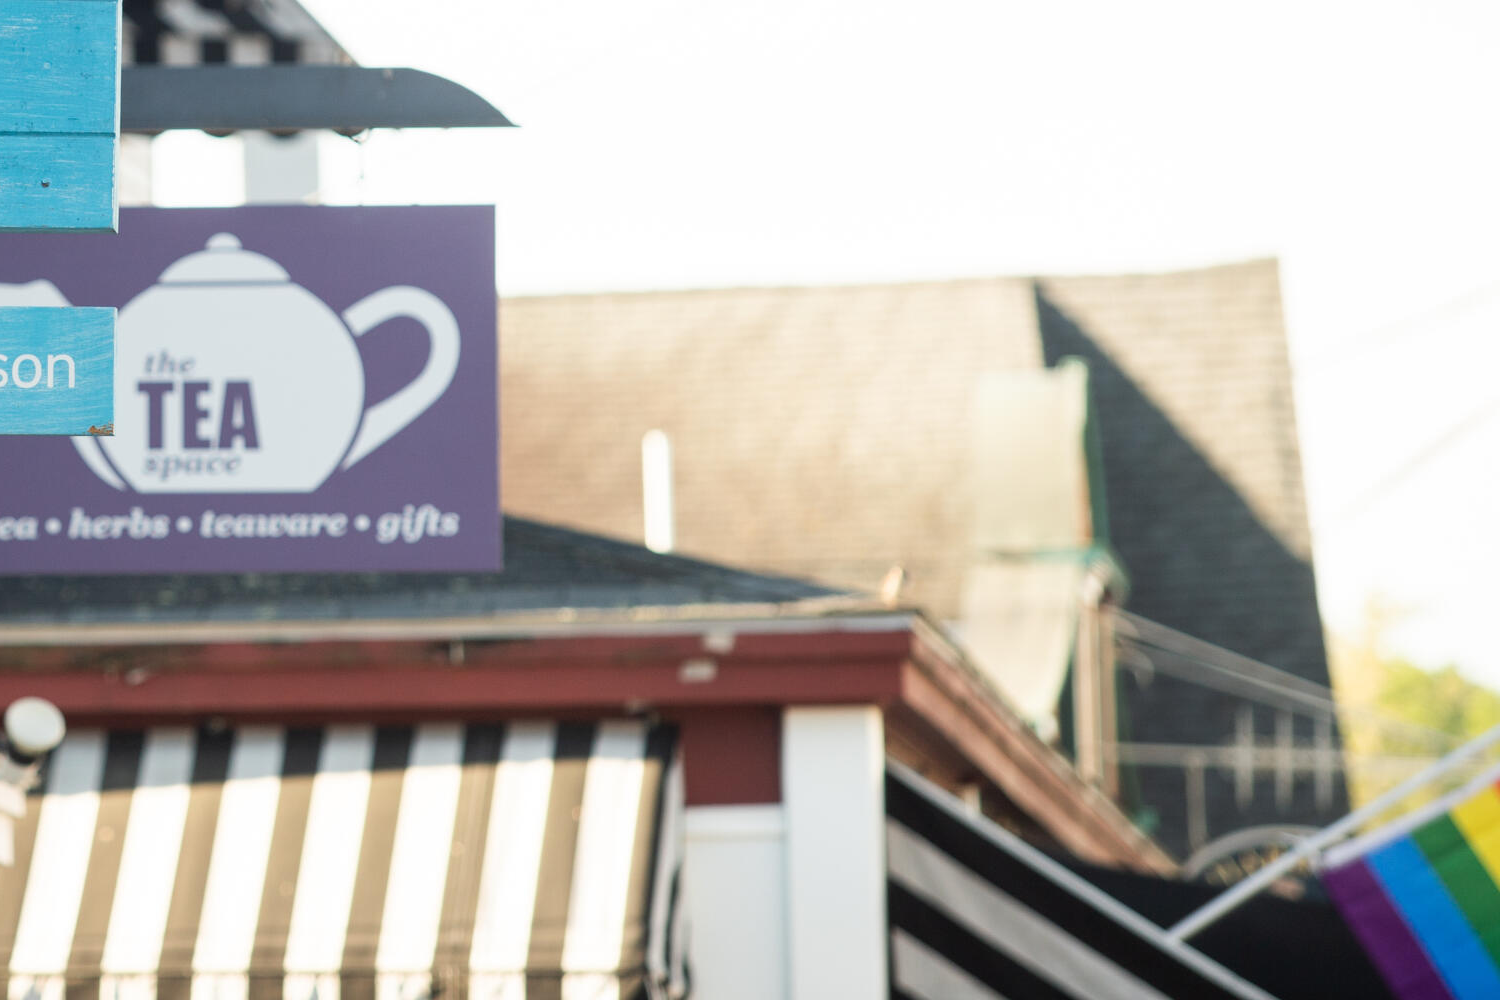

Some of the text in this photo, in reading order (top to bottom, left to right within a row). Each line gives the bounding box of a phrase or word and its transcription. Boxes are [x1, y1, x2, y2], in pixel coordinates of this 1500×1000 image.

[144, 349, 195, 374] the
[136, 380, 260, 450] TEA
[143, 456, 242, 481] space
[68, 507, 170, 540] herbs
[199, 509, 348, 539] teaware
[375, 503, 460, 544] gifts
